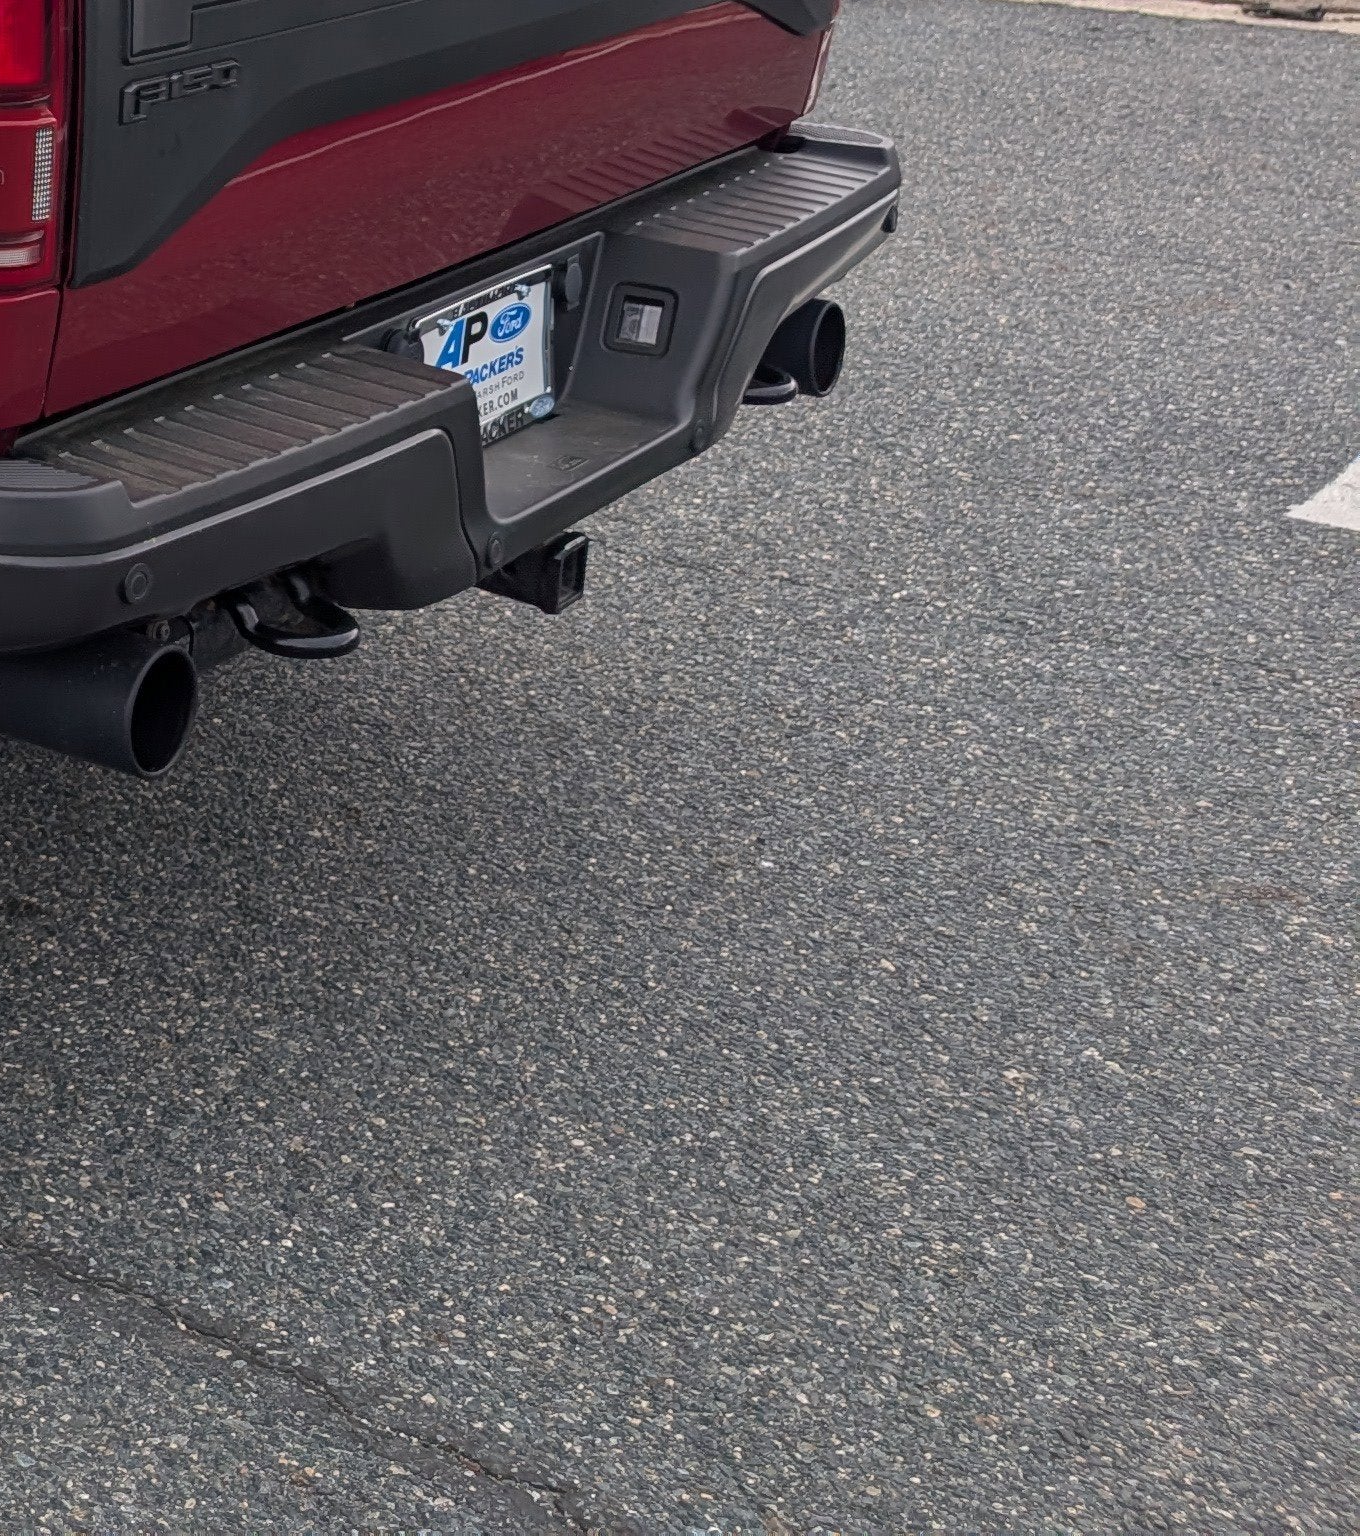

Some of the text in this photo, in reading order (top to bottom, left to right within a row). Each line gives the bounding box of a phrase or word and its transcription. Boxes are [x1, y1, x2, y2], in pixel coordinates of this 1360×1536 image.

[435, 310, 489, 370] AP
[464, 345, 524, 385] PACKER'S
[502, 370, 525, 389] FORD
